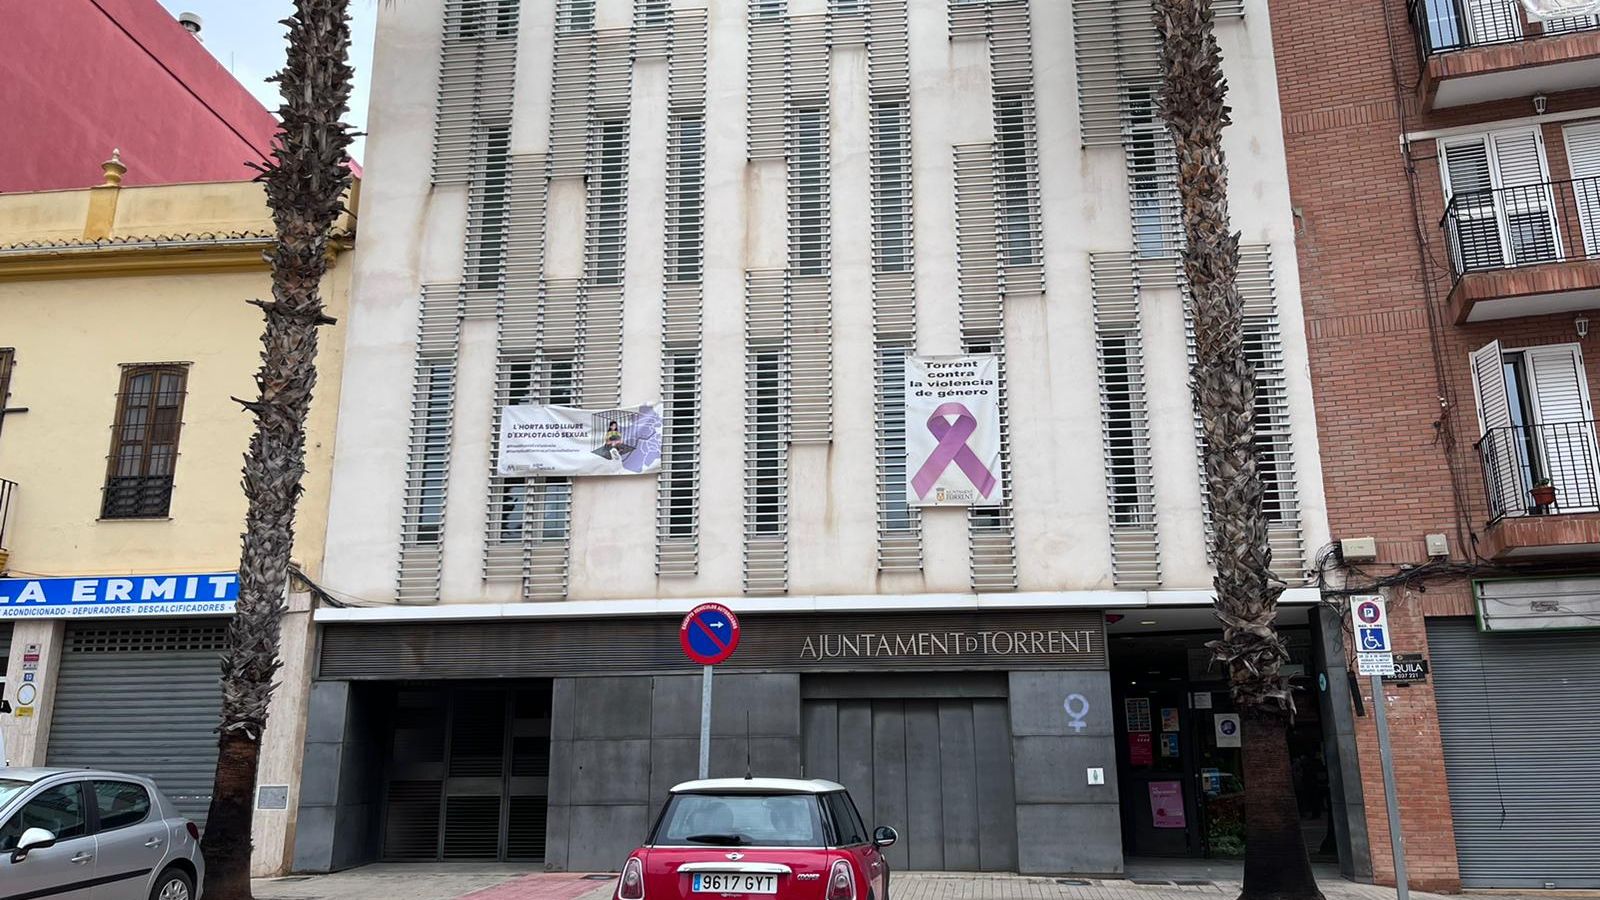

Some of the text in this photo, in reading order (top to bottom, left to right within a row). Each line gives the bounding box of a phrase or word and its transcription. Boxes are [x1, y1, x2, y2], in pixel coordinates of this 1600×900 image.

[937, 388, 988, 398] género
[0, 577, 236, 603] A ERMIT
[3, 603, 225, 617] ACONDICIONADO DEPURADORES DESCALCIFICADORES
[800, 631, 965, 661] AJUNTAMENT
[977, 629, 1095, 656] TORRENT
[1393, 663, 1423, 673] QUILA
[703, 875, 774, 891] 9617 GYT
